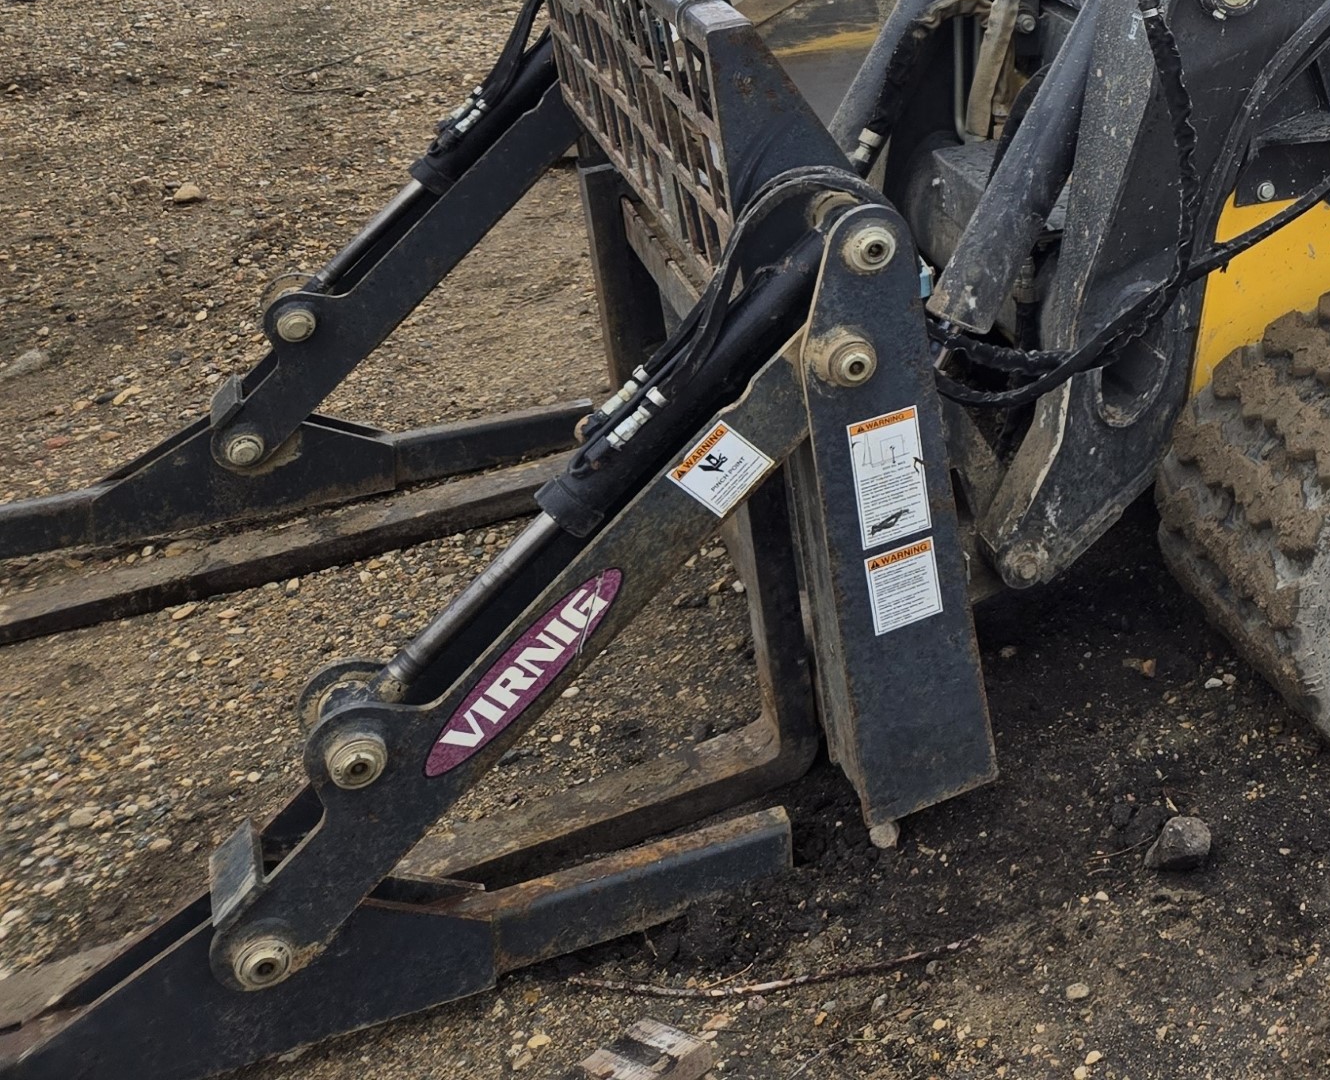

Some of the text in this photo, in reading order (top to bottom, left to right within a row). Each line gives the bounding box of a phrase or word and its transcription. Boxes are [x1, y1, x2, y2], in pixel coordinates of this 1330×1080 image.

[866, 413, 905, 430] WARNING
[683, 428, 725, 469] WARNING
[711, 456, 745, 493] PINCH POINT
[881, 543, 927, 565] WARNING
[438, 588, 610, 748] VIRNIG
